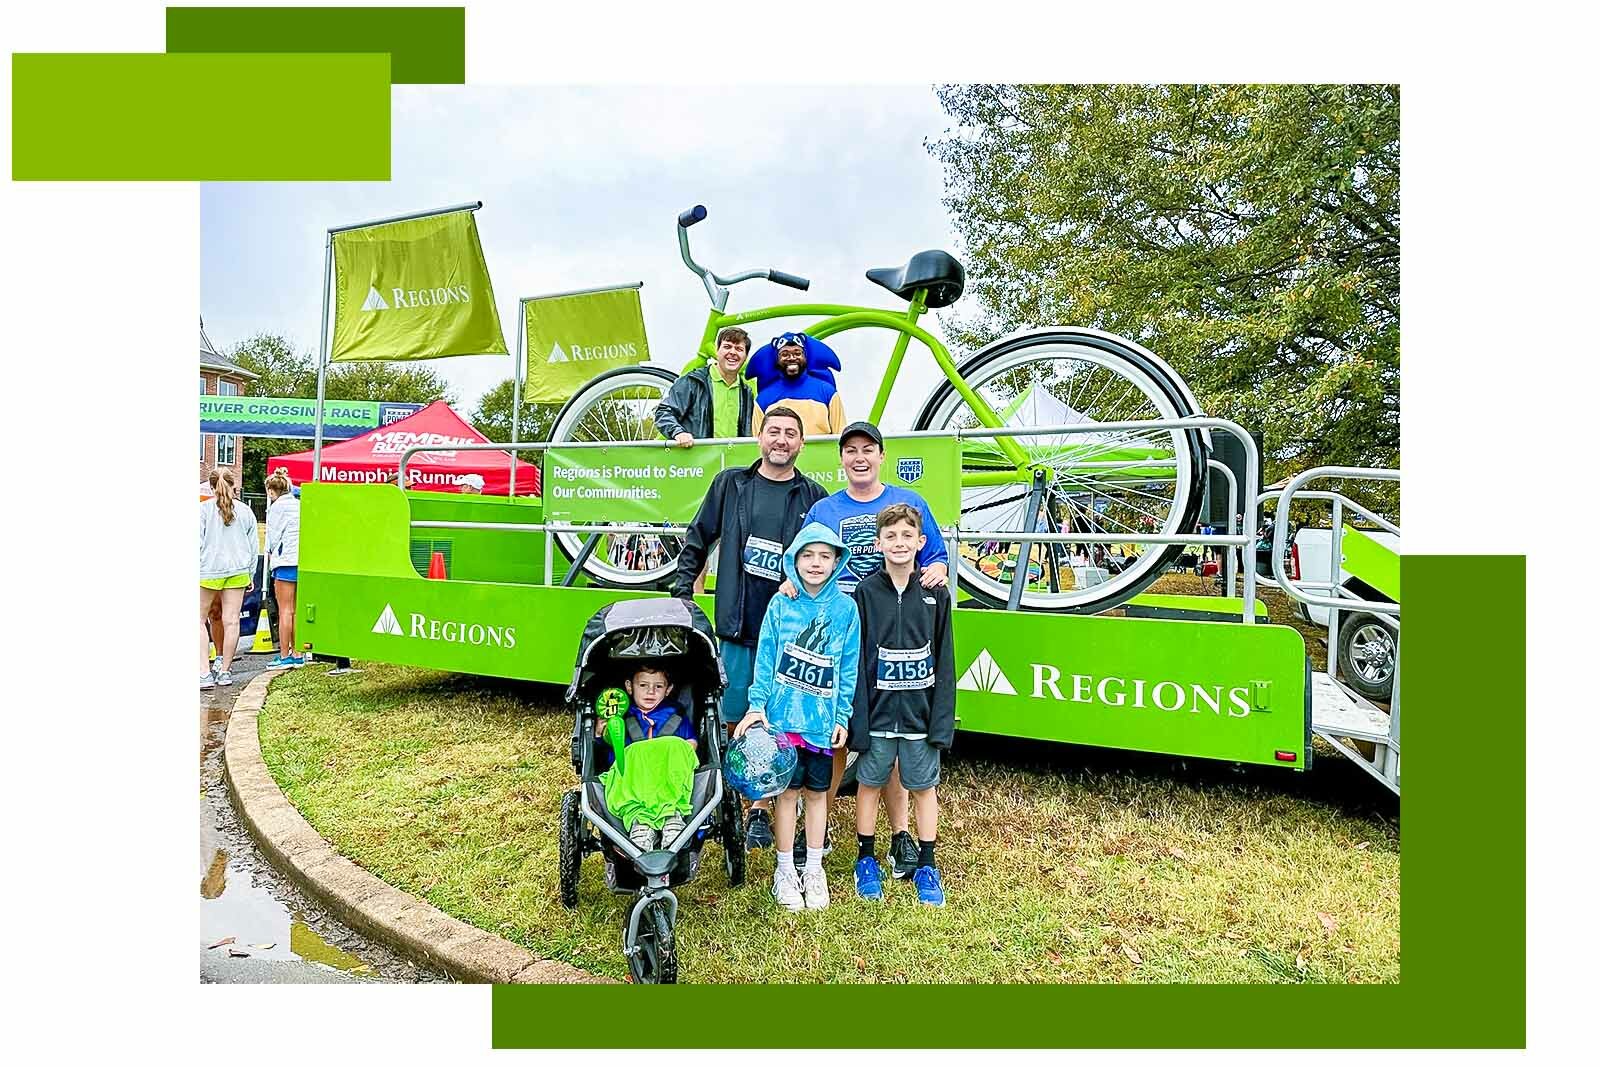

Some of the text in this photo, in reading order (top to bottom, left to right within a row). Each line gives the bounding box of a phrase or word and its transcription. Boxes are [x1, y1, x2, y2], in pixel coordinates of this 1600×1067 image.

[392, 285, 471, 308] REGIONS
[570, 341, 637, 362] REGIONS
[200, 402, 371, 419] RIVER CROSSIN RACE
[553, 464, 704, 481] Regions is Proud to Serve
[899, 464, 921, 473] POWER
[552, 485, 662, 499] Our Communities.
[409, 612, 516, 649] REGIONS
[785, 657, 825, 686] 2161
[884, 660, 928, 680] 2158
[1029, 663, 1251, 719] REGIONS
